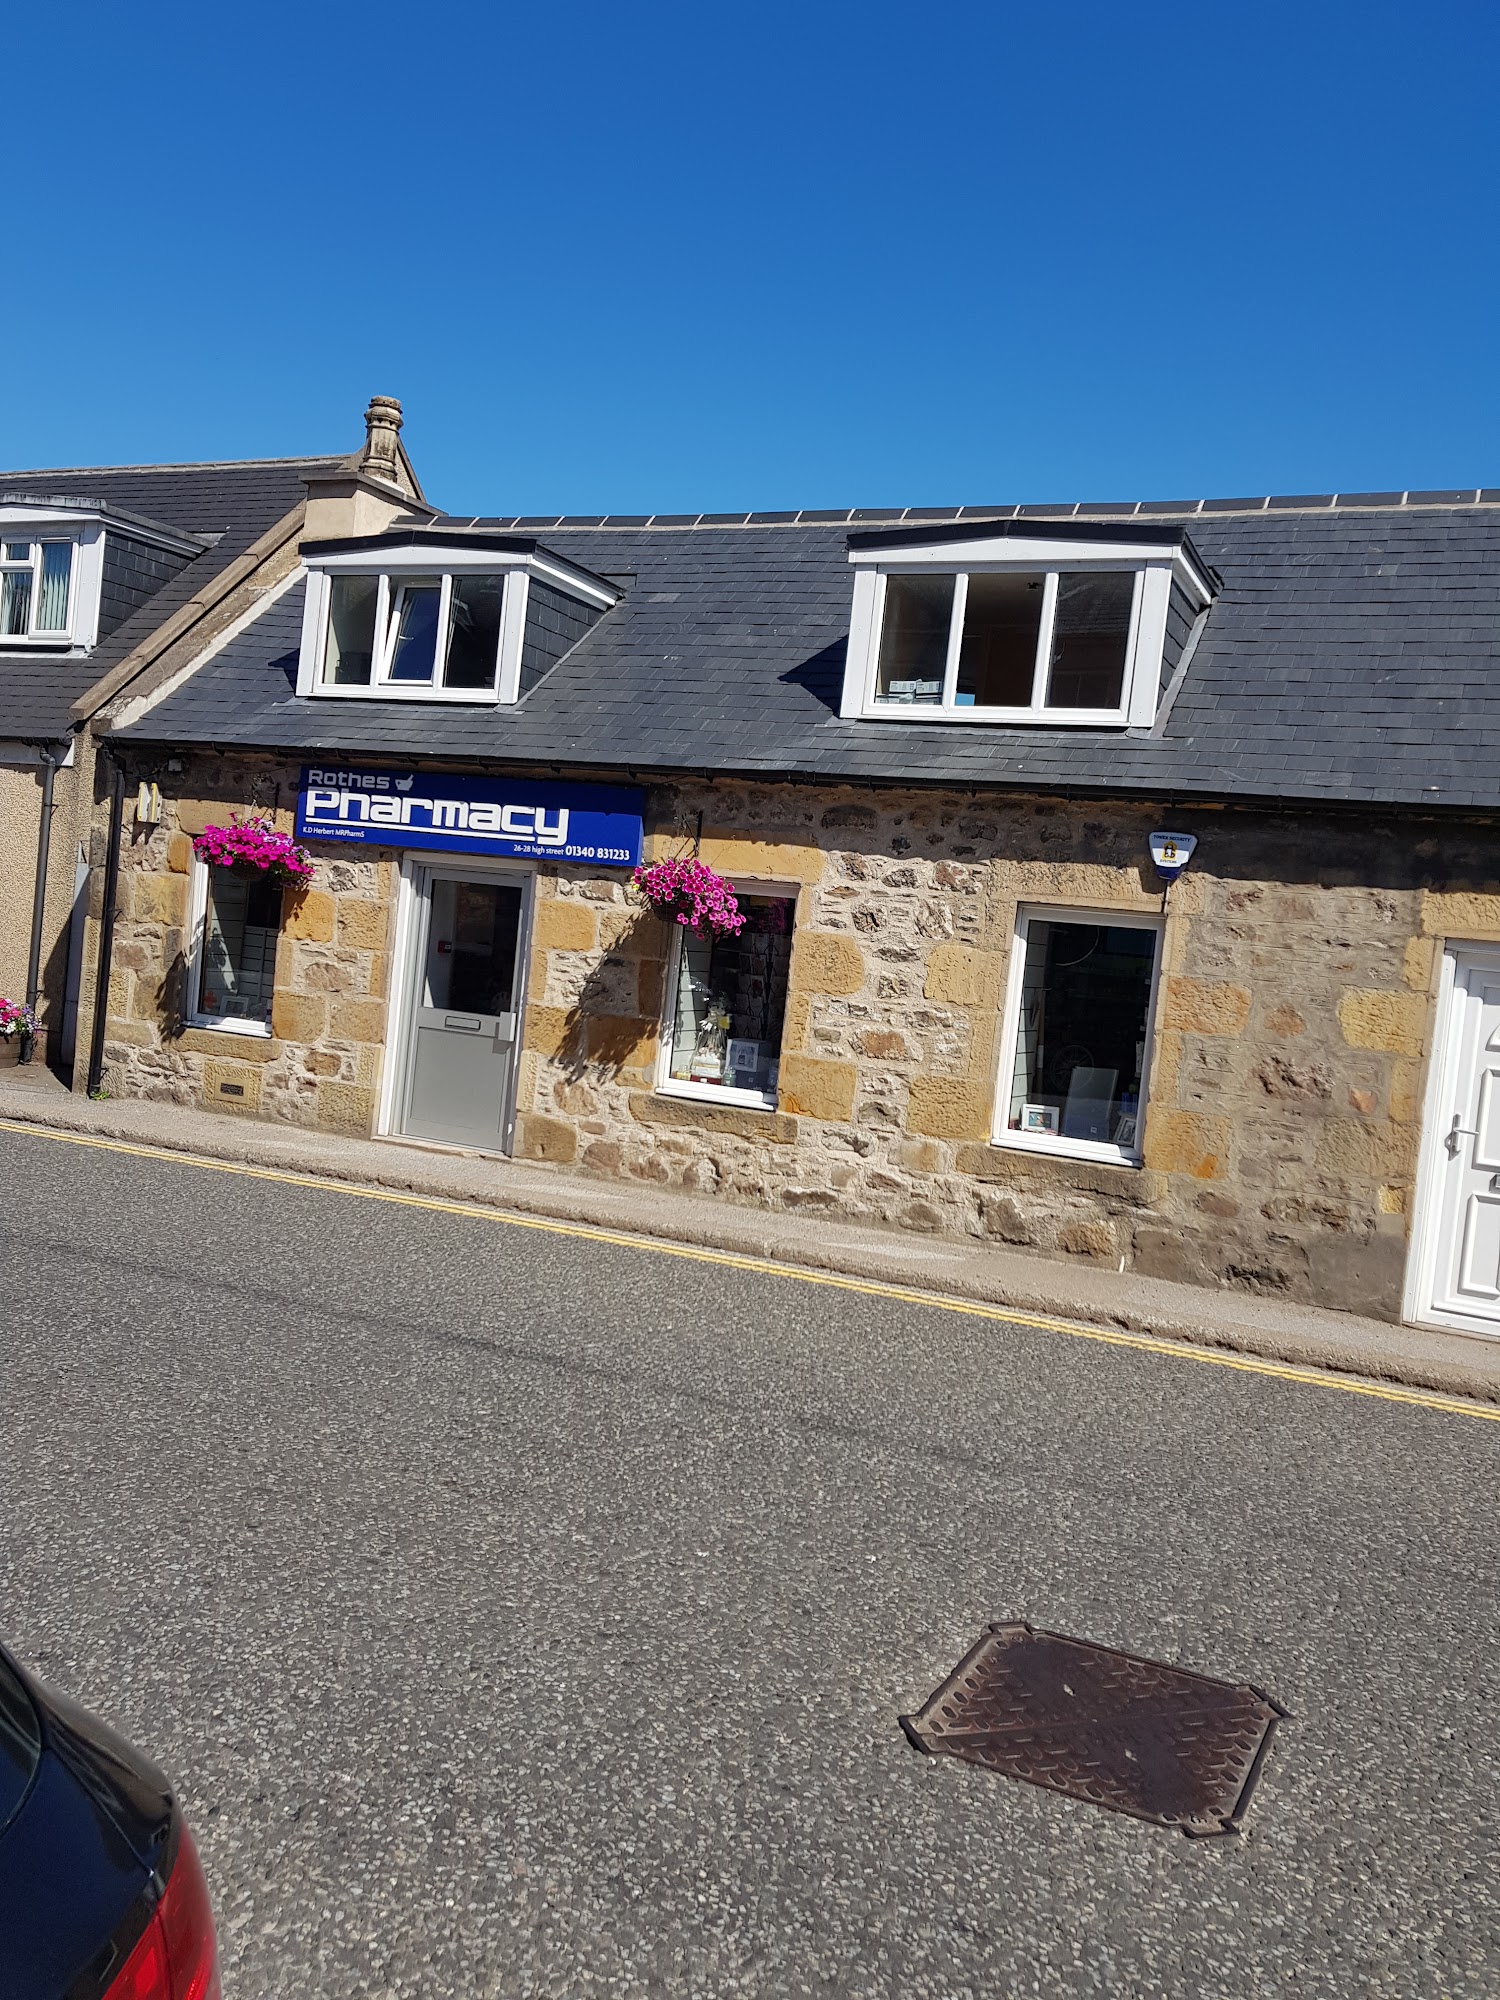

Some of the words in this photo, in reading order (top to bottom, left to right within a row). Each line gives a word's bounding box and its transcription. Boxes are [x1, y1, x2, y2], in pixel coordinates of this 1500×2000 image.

[308, 769, 391, 789] Rothes
[305, 786, 569, 846] Pharmacy
[313, 827, 334, 835] Herbert
[335, 829, 365, 838] MRPharmS
[513, 844, 531, 853] 26-28
[531, 846, 545, 855] high
[565, 845, 595, 858] 01340
[597, 848, 630, 861] 831233
